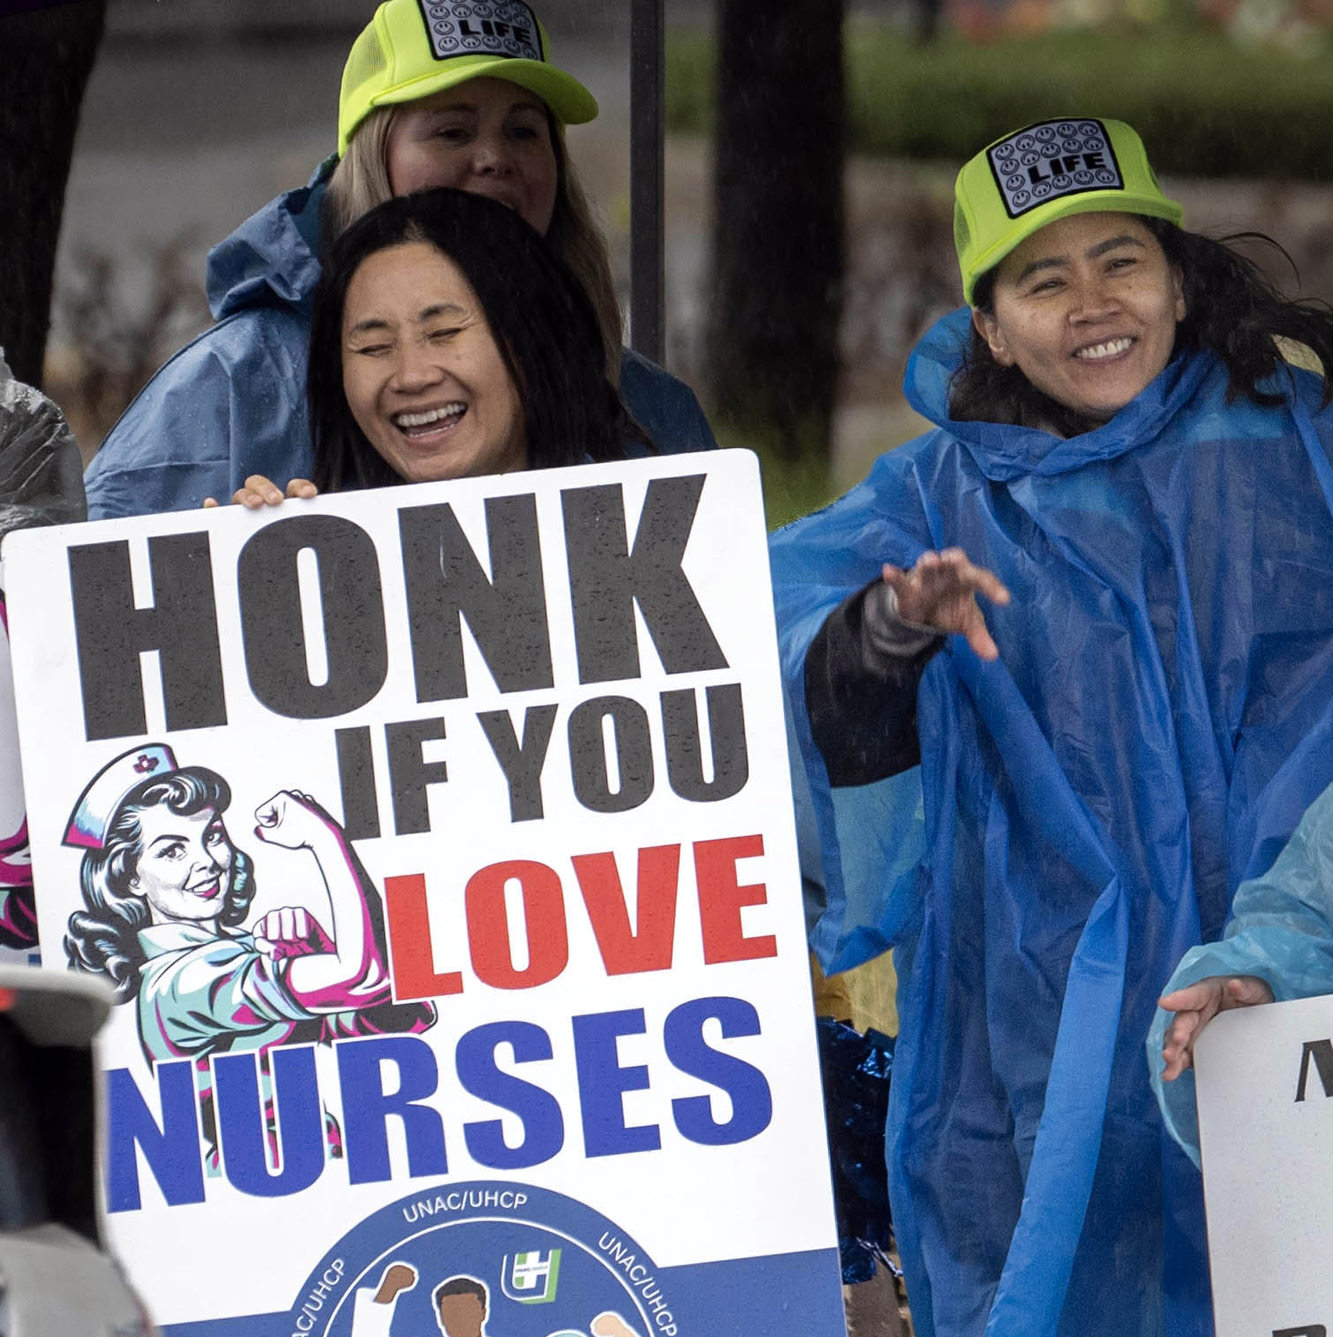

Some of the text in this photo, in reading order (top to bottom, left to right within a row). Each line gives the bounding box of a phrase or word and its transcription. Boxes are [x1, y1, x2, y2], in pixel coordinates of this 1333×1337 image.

[459, 20, 532, 46] LIFE
[1028, 152, 1106, 184] LIFE
[67, 472, 730, 741] HONK
[335, 683, 751, 841] IF YOU
[383, 834, 778, 1005] LOVE
[106, 996, 773, 1214] NURSES
[403, 1191, 528, 1223] UNAC/UHCP
